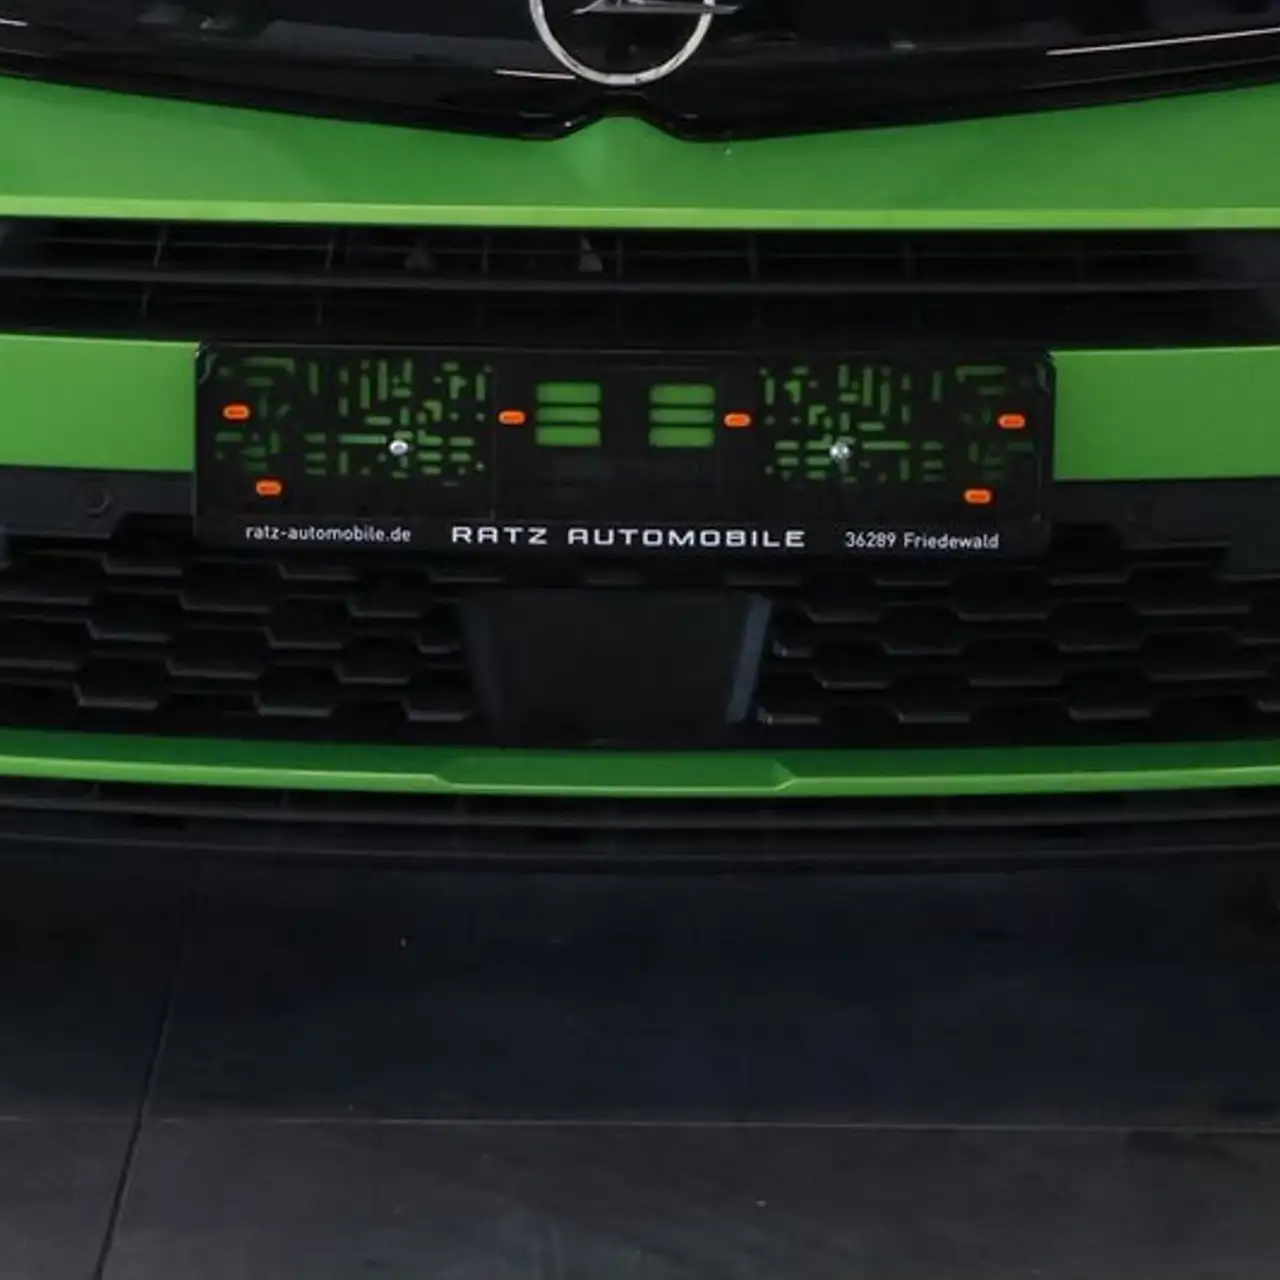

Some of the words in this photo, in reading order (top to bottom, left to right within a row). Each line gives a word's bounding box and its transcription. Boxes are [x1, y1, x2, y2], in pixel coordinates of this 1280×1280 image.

[245, 524, 412, 543] ratz-automobile.de
[451, 525, 548, 545] RATZ
[567, 528, 806, 549] AUTOMOBILE
[844, 531, 897, 549] 36289
[902, 531, 1000, 550] Friedewald
